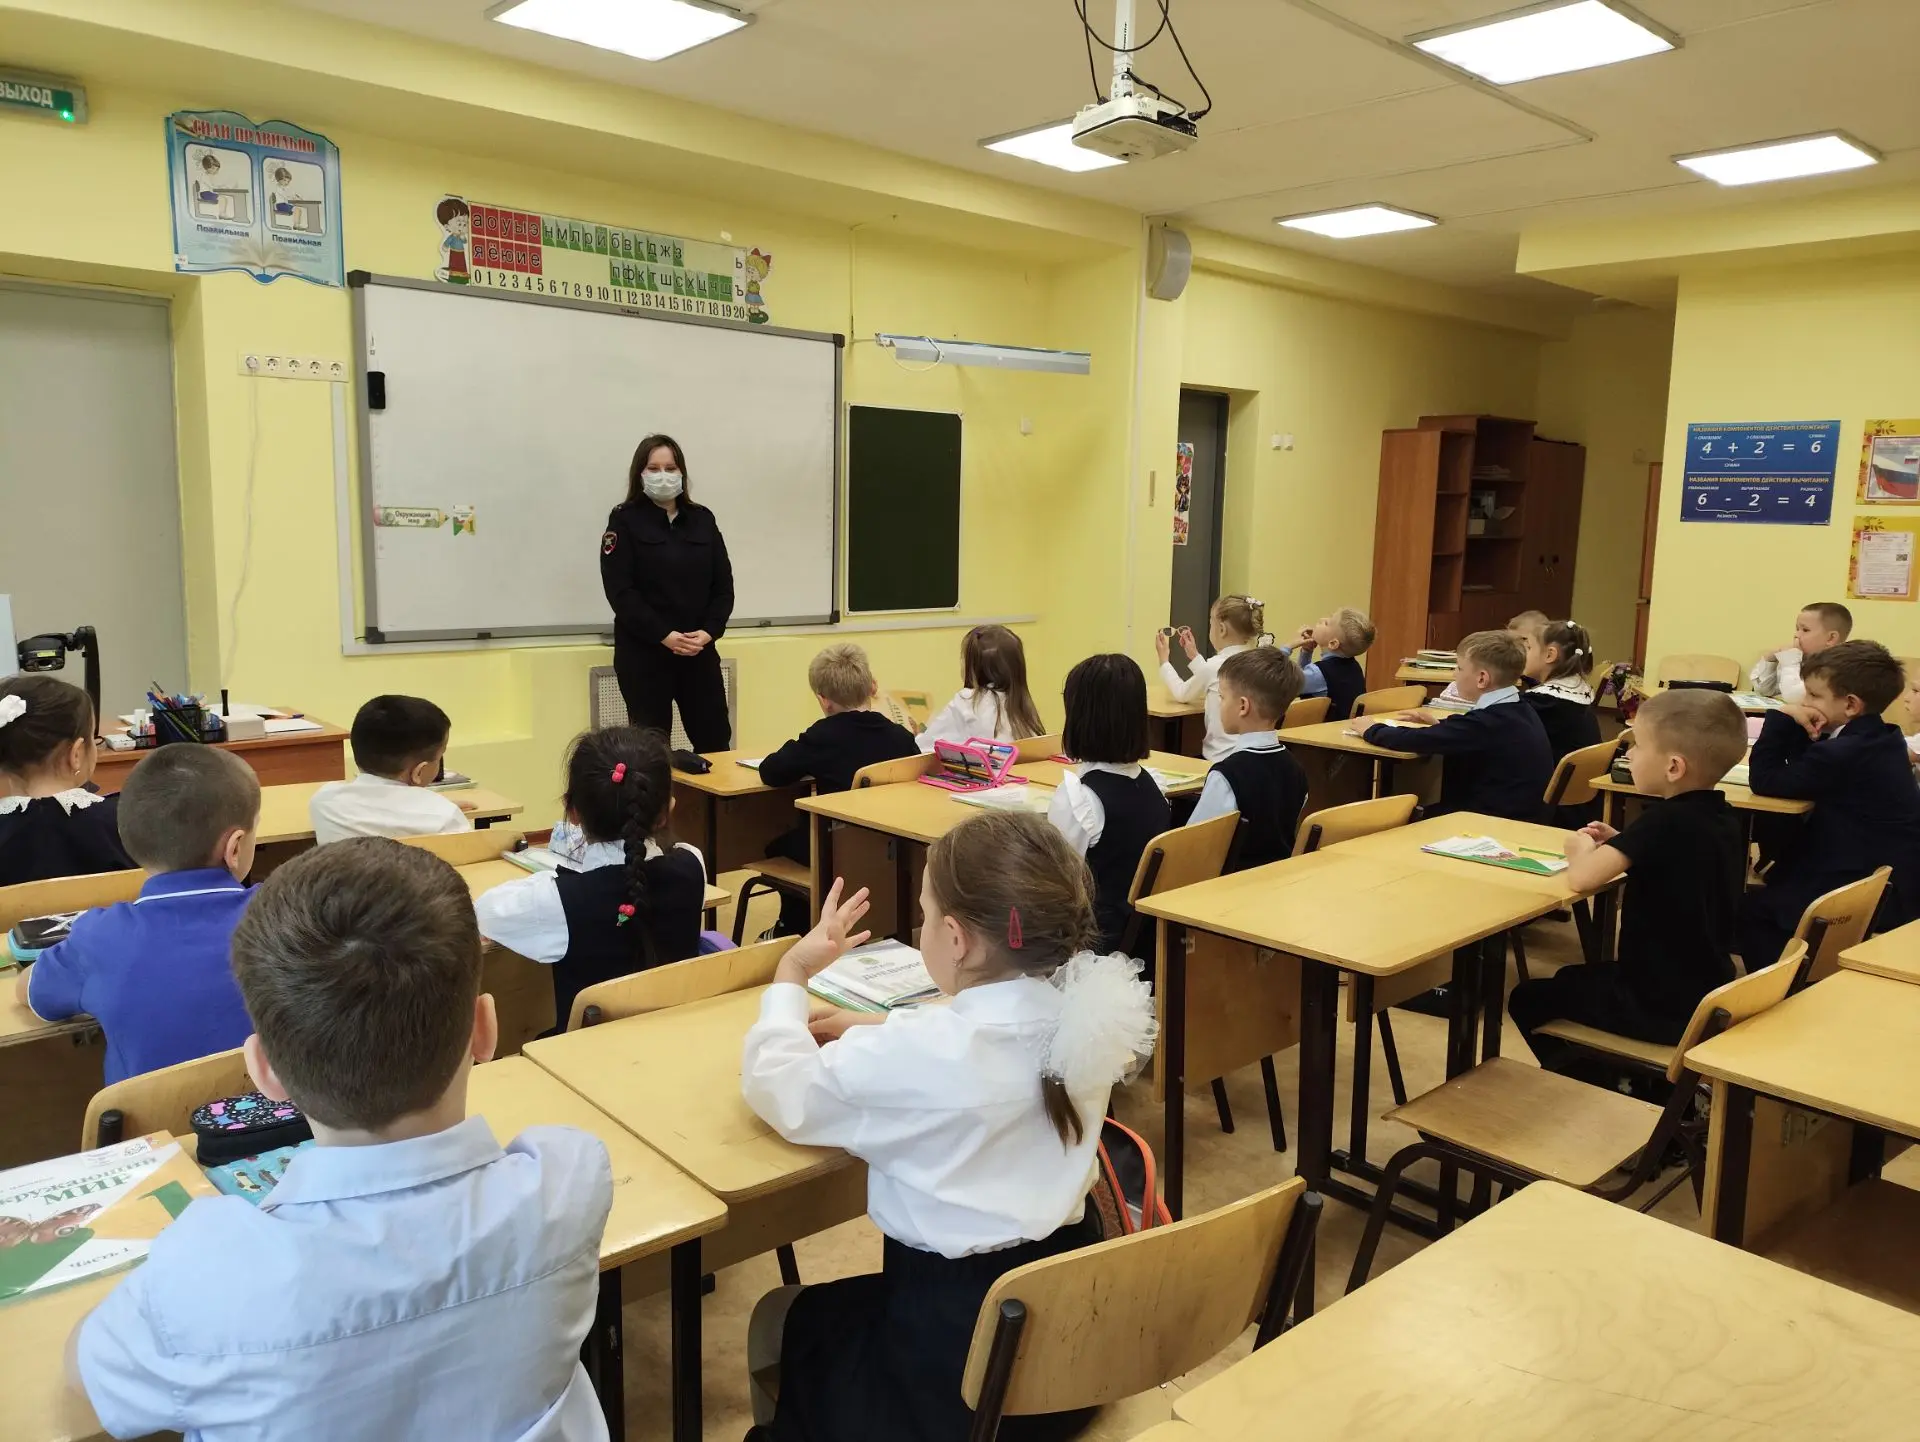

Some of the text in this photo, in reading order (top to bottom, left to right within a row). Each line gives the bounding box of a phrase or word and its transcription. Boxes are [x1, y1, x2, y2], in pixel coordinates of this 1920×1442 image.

[597, 286, 609, 301] 10
[613, 288, 623, 303] 11
[627, 290, 638, 305] 12
[640, 292, 652, 307] 13
[655, 294, 666, 309] 14
[669, 296, 679, 311] 15
[682, 298, 693, 313] 16
[695, 300, 705, 314] 17
[708, 302, 719, 316] 18
[722, 303, 732, 318] 19
[733, 305, 745, 319] 20
[1702, 442, 1712, 454] 4
[1754, 441, 1765, 454] 2
[1811, 441, 1822, 453] 6
[1697, 493, 1707, 505] 6
[1749, 493, 1760, 506] 2
[1805, 494, 1816, 507] 4
